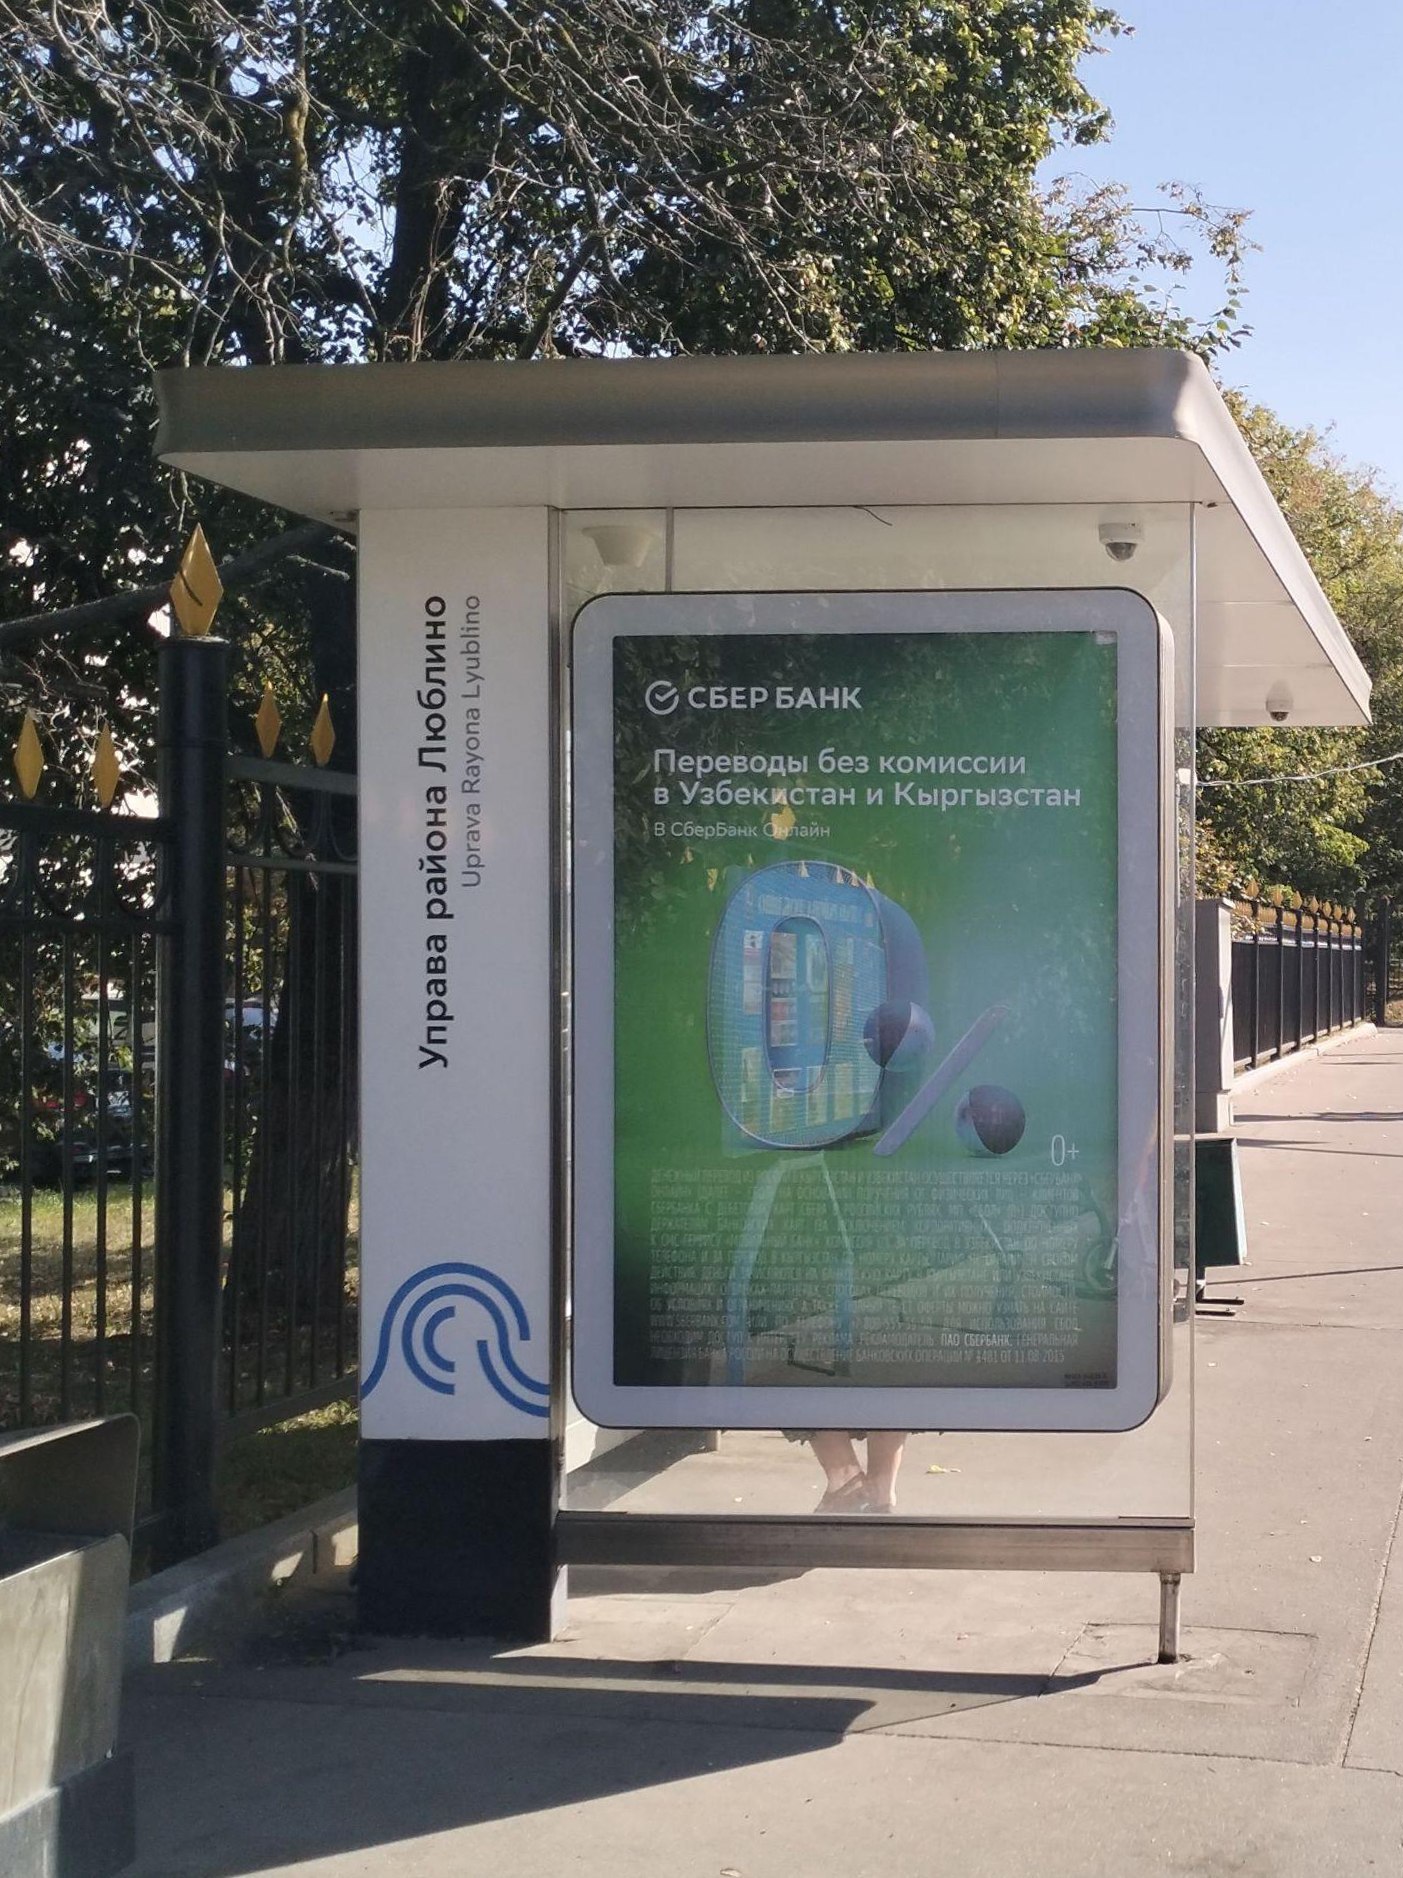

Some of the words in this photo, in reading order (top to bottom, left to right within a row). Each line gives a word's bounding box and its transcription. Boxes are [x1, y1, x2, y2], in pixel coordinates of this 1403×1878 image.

[460, 595, 485, 699] Lyublino
[416, 595, 448, 773] Люблино
[688, 686, 769, 710] СБЕР
[775, 686, 863, 710] БАНК
[461, 707, 485, 794] Rayona
[653, 748, 809, 777] Переводы
[818, 748, 869, 774] без
[879, 754, 1027, 774] комиссии
[653, 785, 669, 806] в
[679, 780, 857, 806] Узбекистан
[866, 785, 884, 806] и
[894, 782, 1082, 812] Кыргызстан
[418, 785, 455, 920] района
[461, 803, 485, 888] Uprava
[654, 822, 666, 837] В
[671, 821, 758, 839] СберБанк
[417, 933, 455, 1070] Управа
[1050, 1134, 1081, 1167] 0+
[940, 1333, 960, 1347] ПАО
